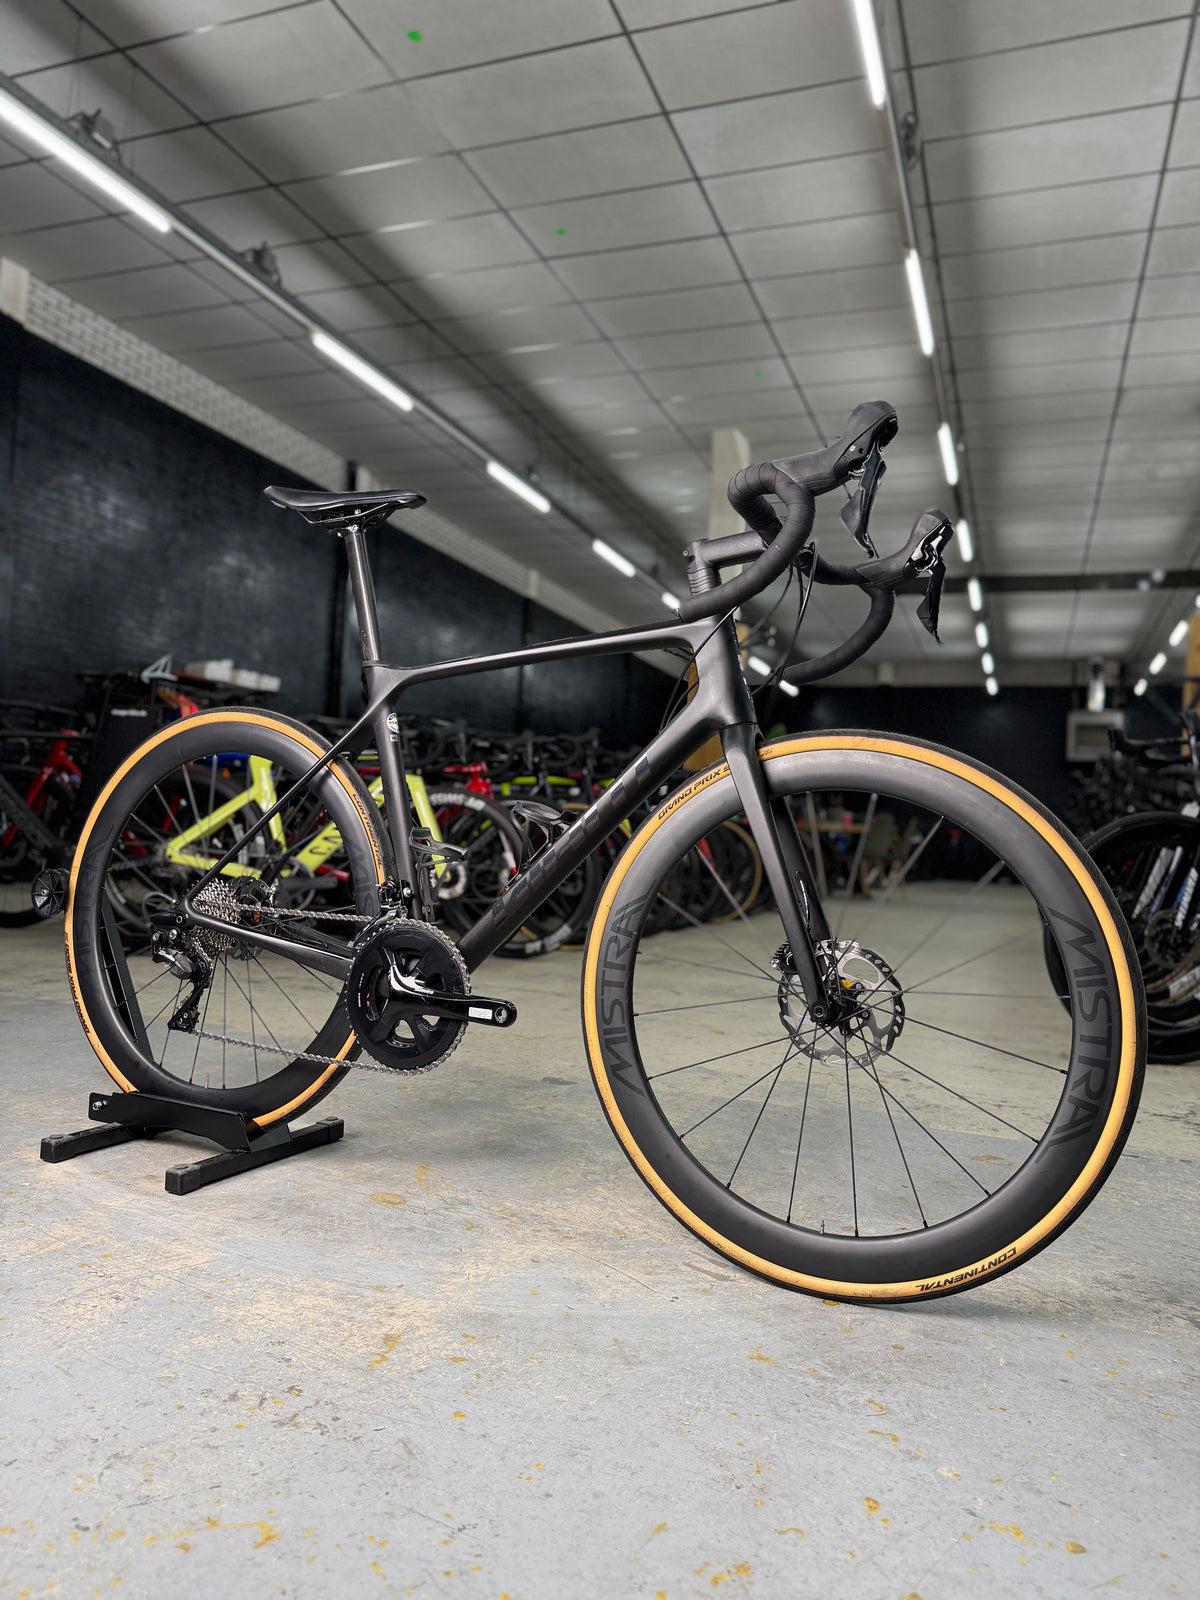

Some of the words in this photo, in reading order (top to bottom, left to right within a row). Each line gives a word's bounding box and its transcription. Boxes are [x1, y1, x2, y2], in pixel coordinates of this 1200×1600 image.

[658, 787, 692, 820] GRAND
[694, 768, 721, 790] PRIX
[915, 1247, 1017, 1292] CONTINENTAL
